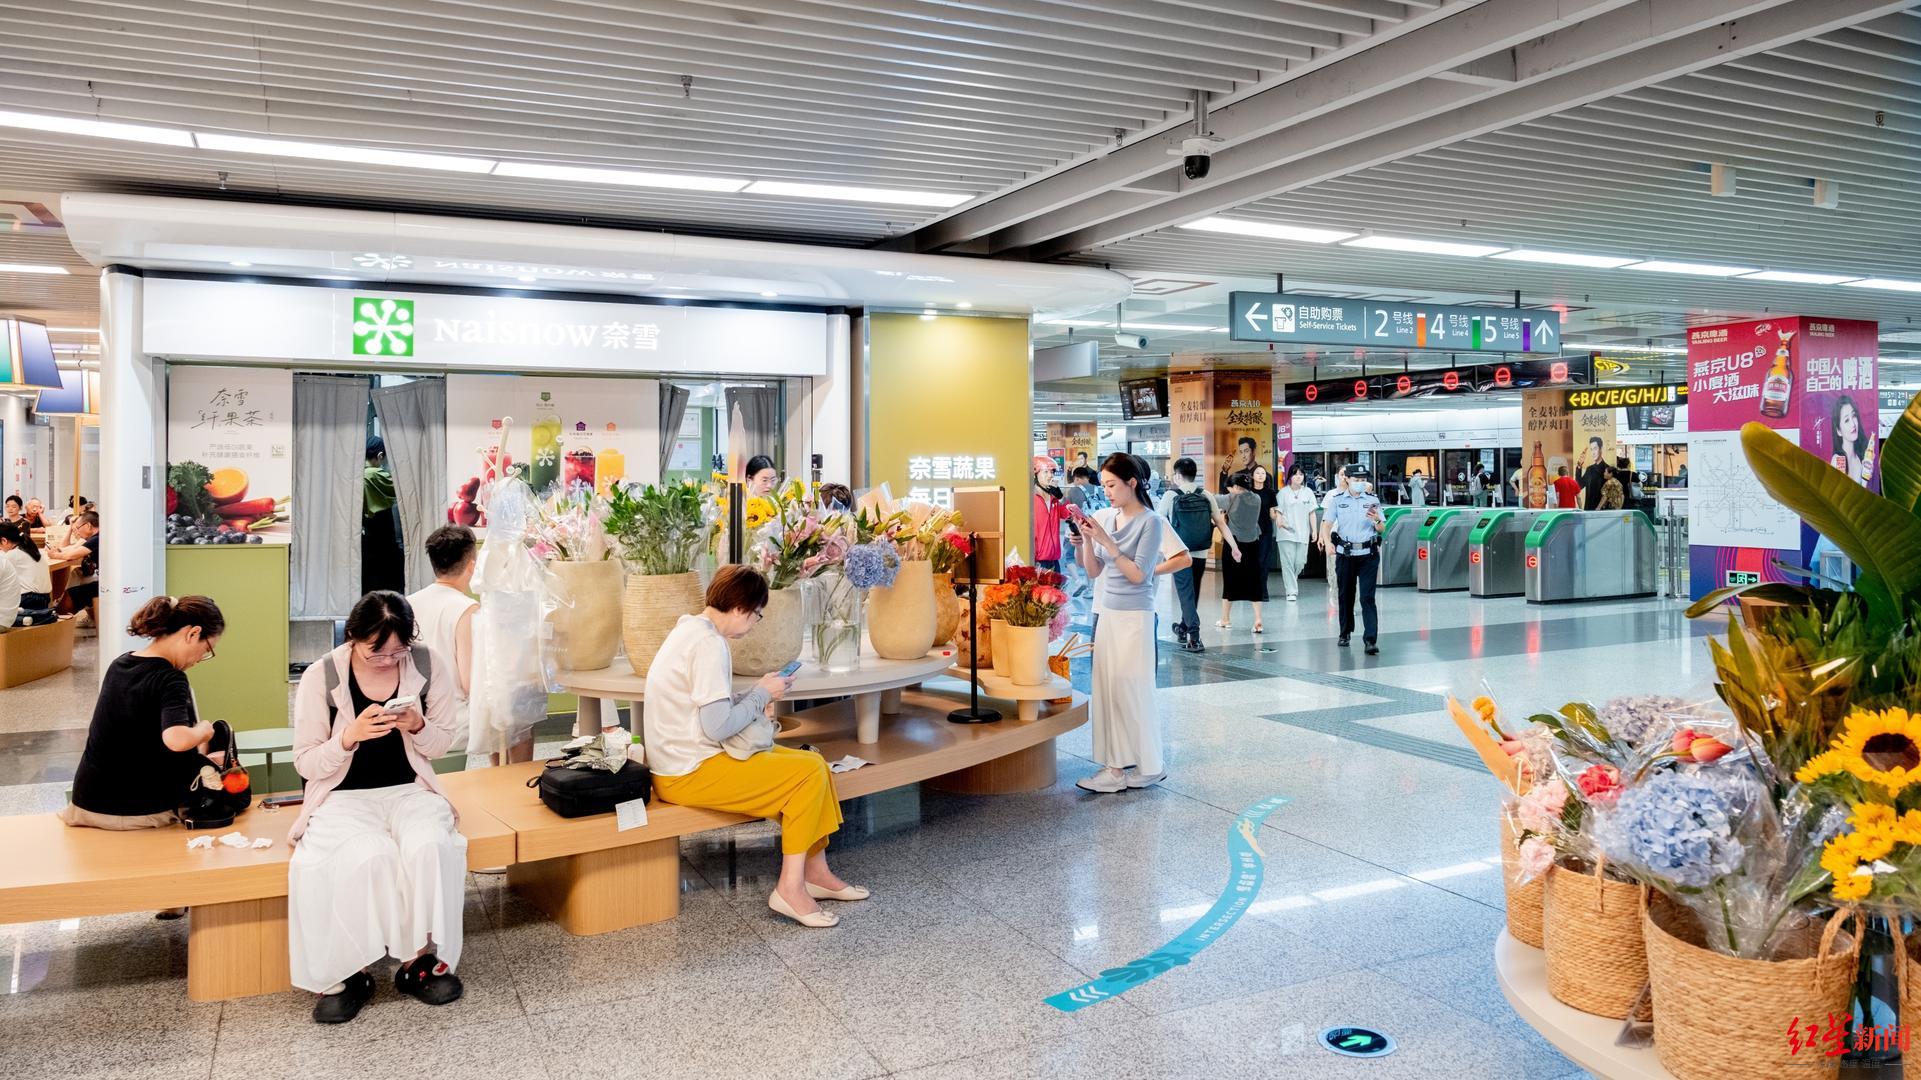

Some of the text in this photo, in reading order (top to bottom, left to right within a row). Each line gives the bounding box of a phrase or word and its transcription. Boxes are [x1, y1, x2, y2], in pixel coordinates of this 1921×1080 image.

[1299, 306, 1343, 321] 自助购票
[1375, 309, 1414, 337] 2 号线
[433, 309, 661, 351] Naisnow 奈雪
[1299, 320, 1357, 332] Self-Service Tickets
[1430, 313, 1469, 340] 4 号线
[1464, 329, 1469, 337] 4
[1484, 316, 1520, 343] 5 号线
[1515, 332, 1520, 340] 5
[1693, 351, 1754, 378] 燕京U8
[1806, 357, 1842, 375] 中国人
[1693, 372, 1740, 392] 小度酒
[1806, 375, 1842, 392] 自己的
[210, 387, 249, 407] 奈雪
[1580, 387, 1668, 407] B/C/E/G/H/J
[1713, 384, 1760, 404] 大滋味
[908, 455, 997, 480] 奈雪蔬果
